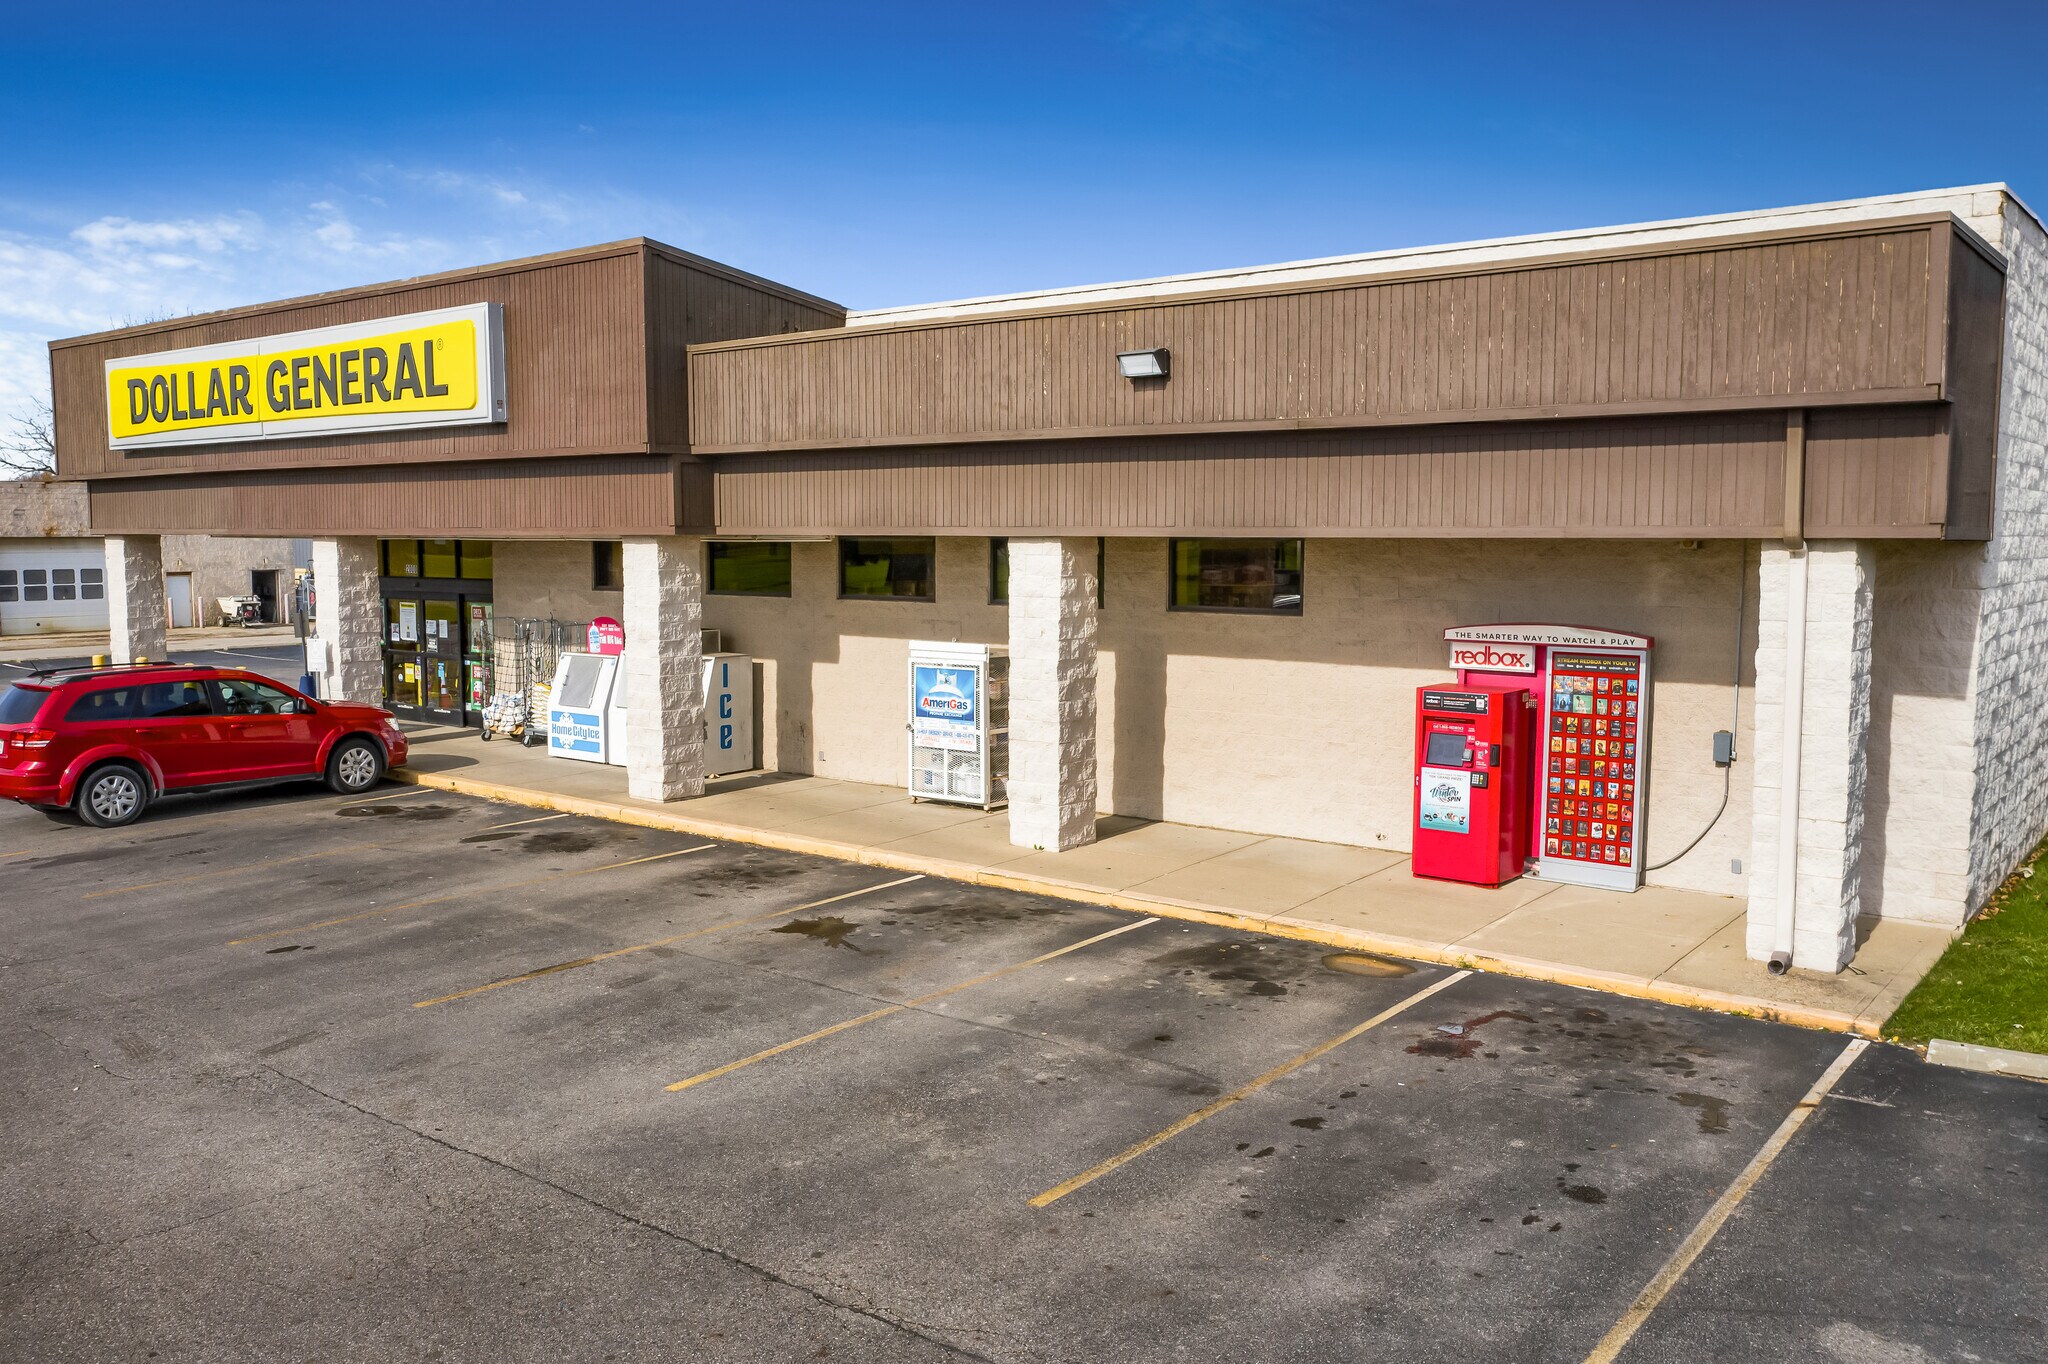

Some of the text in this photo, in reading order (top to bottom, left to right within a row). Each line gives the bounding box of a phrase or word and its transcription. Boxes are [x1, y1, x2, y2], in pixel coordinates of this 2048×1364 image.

[127, 339, 448, 424] DOLLAR GENERAL
[1475, 632, 1519, 641] SMARTER
[1522, 634, 1543, 642] WAY
[1546, 635, 1558, 643] TO
[1562, 636, 1596, 645] WATCH
[1610, 638, 1636, 646] PLAY
[1454, 645, 1525, 668] redbox
[473, 670, 490, 679] SWETS
[922, 697, 968, 710] AmeriGas
[552, 723, 600, 740] Home City Ice
